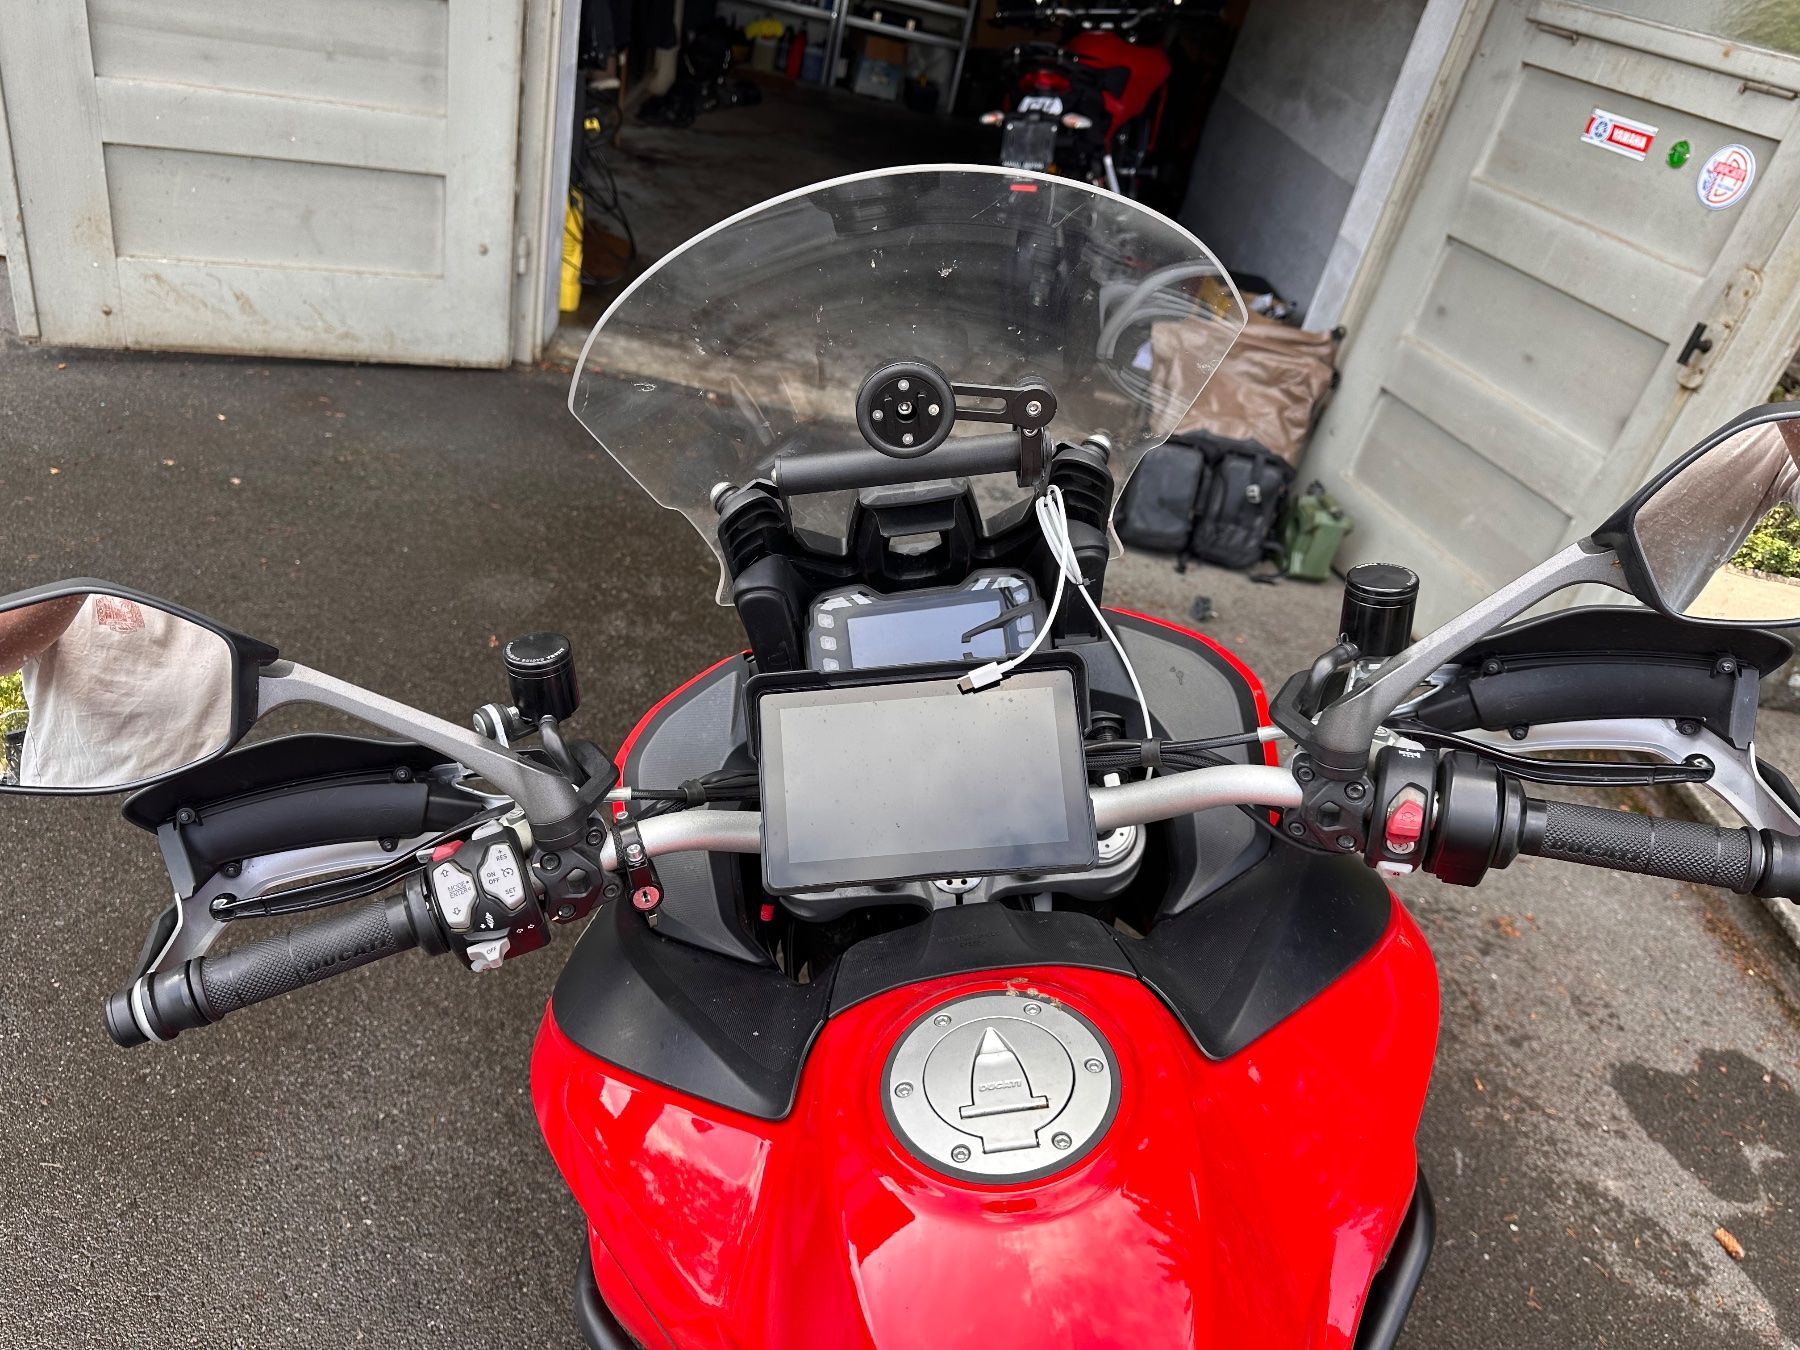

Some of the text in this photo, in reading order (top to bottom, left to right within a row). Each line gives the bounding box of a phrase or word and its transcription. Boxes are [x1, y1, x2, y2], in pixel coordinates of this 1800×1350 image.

[488, 877, 500, 885] OFF
[505, 886, 517, 895] SET
[486, 946, 497, 955] OFF
[978, 1079, 1022, 1092] DUCATI
